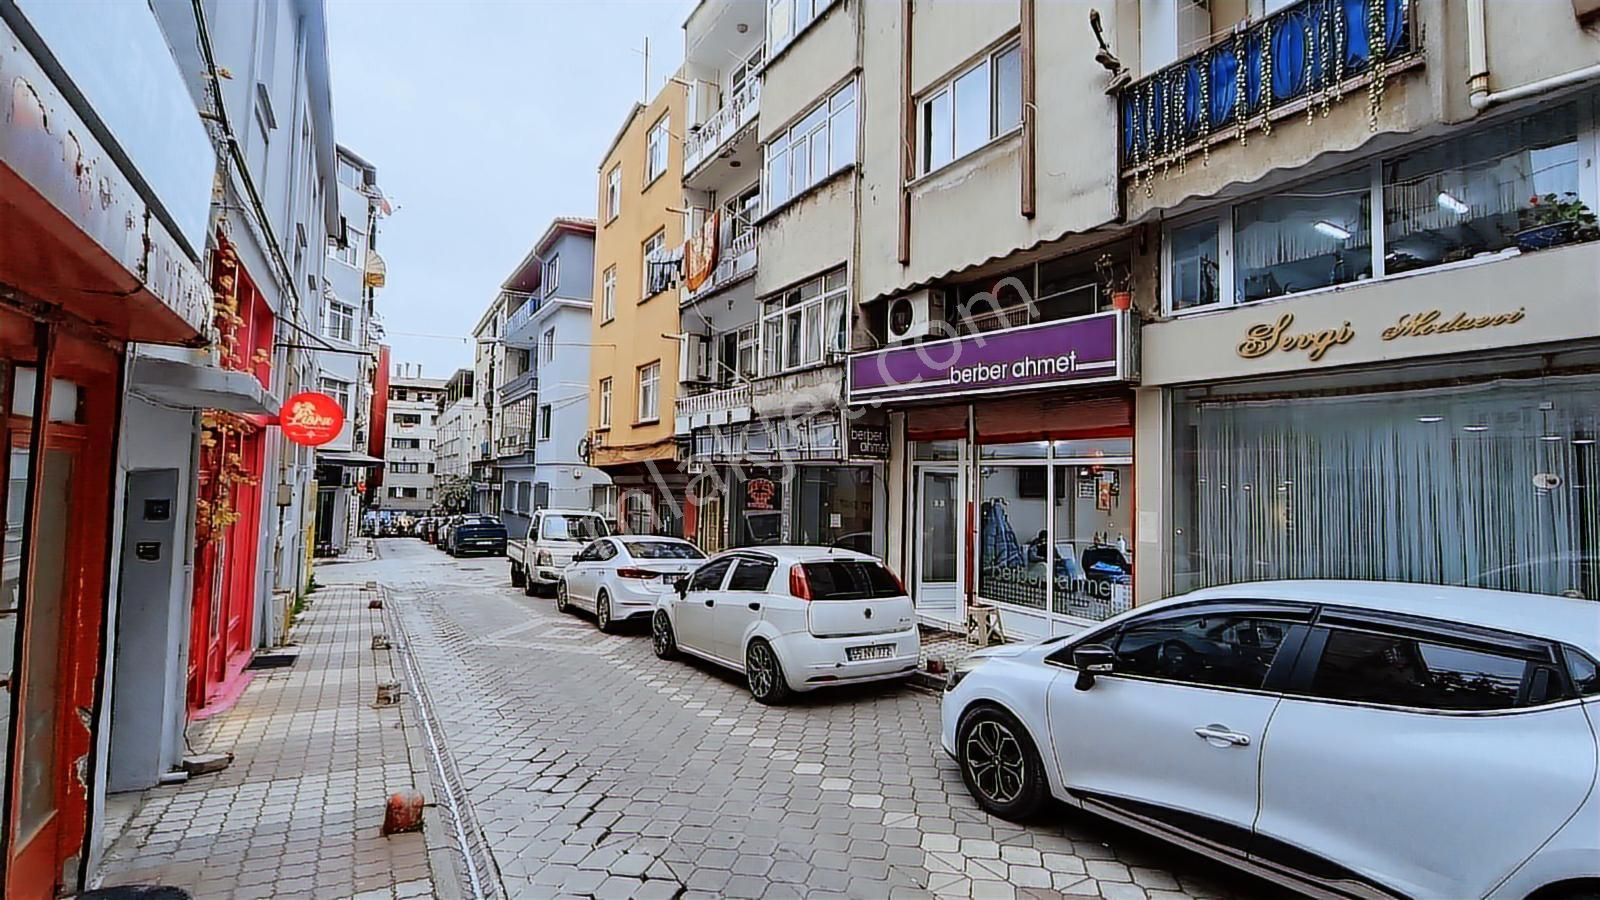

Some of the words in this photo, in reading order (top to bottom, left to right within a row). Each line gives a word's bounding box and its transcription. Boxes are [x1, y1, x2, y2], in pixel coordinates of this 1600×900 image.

[1236, 312, 1355, 361] Sevgi
[1381, 306, 1526, 341] Modaevi
[950, 361, 1008, 384] berber
[1012, 350, 1077, 378] ahmet
